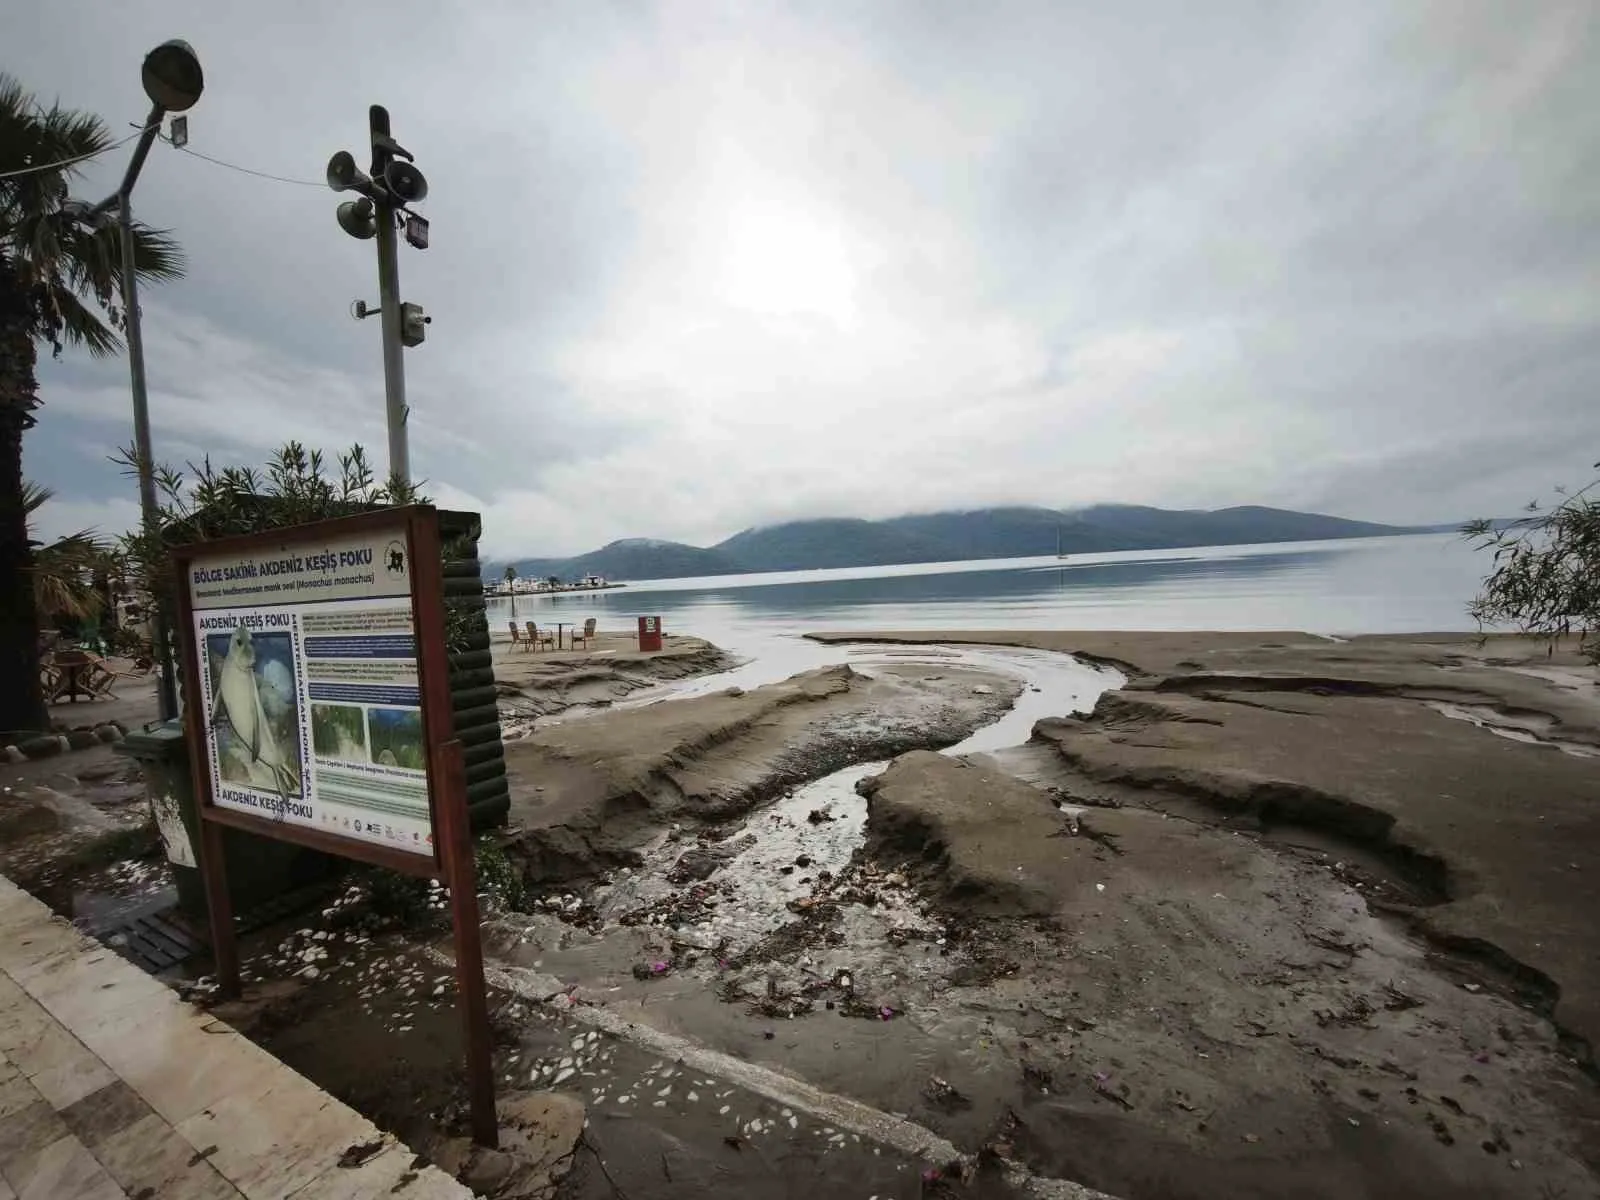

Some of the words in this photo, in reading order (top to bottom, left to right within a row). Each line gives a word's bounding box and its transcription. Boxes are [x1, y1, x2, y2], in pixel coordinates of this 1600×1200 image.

[194, 568, 223, 584] BÖLGE
[260, 554, 304, 577] AKDENİZ
[306, 549, 338, 574] KEŞİŞ
[340, 548, 373, 567] FOKU
[335, 572, 375, 585] monachus)
[200, 612, 237, 629] AKDENİZ
[239, 611, 263, 631] KEŞİŞ
[265, 613, 290, 627] FOKU
[291, 614, 306, 723] MEDITERRANEAN
[302, 726, 311, 763] MONK
[222, 789, 258, 807] AKDENİZ
[287, 802, 313, 819] FOKU
